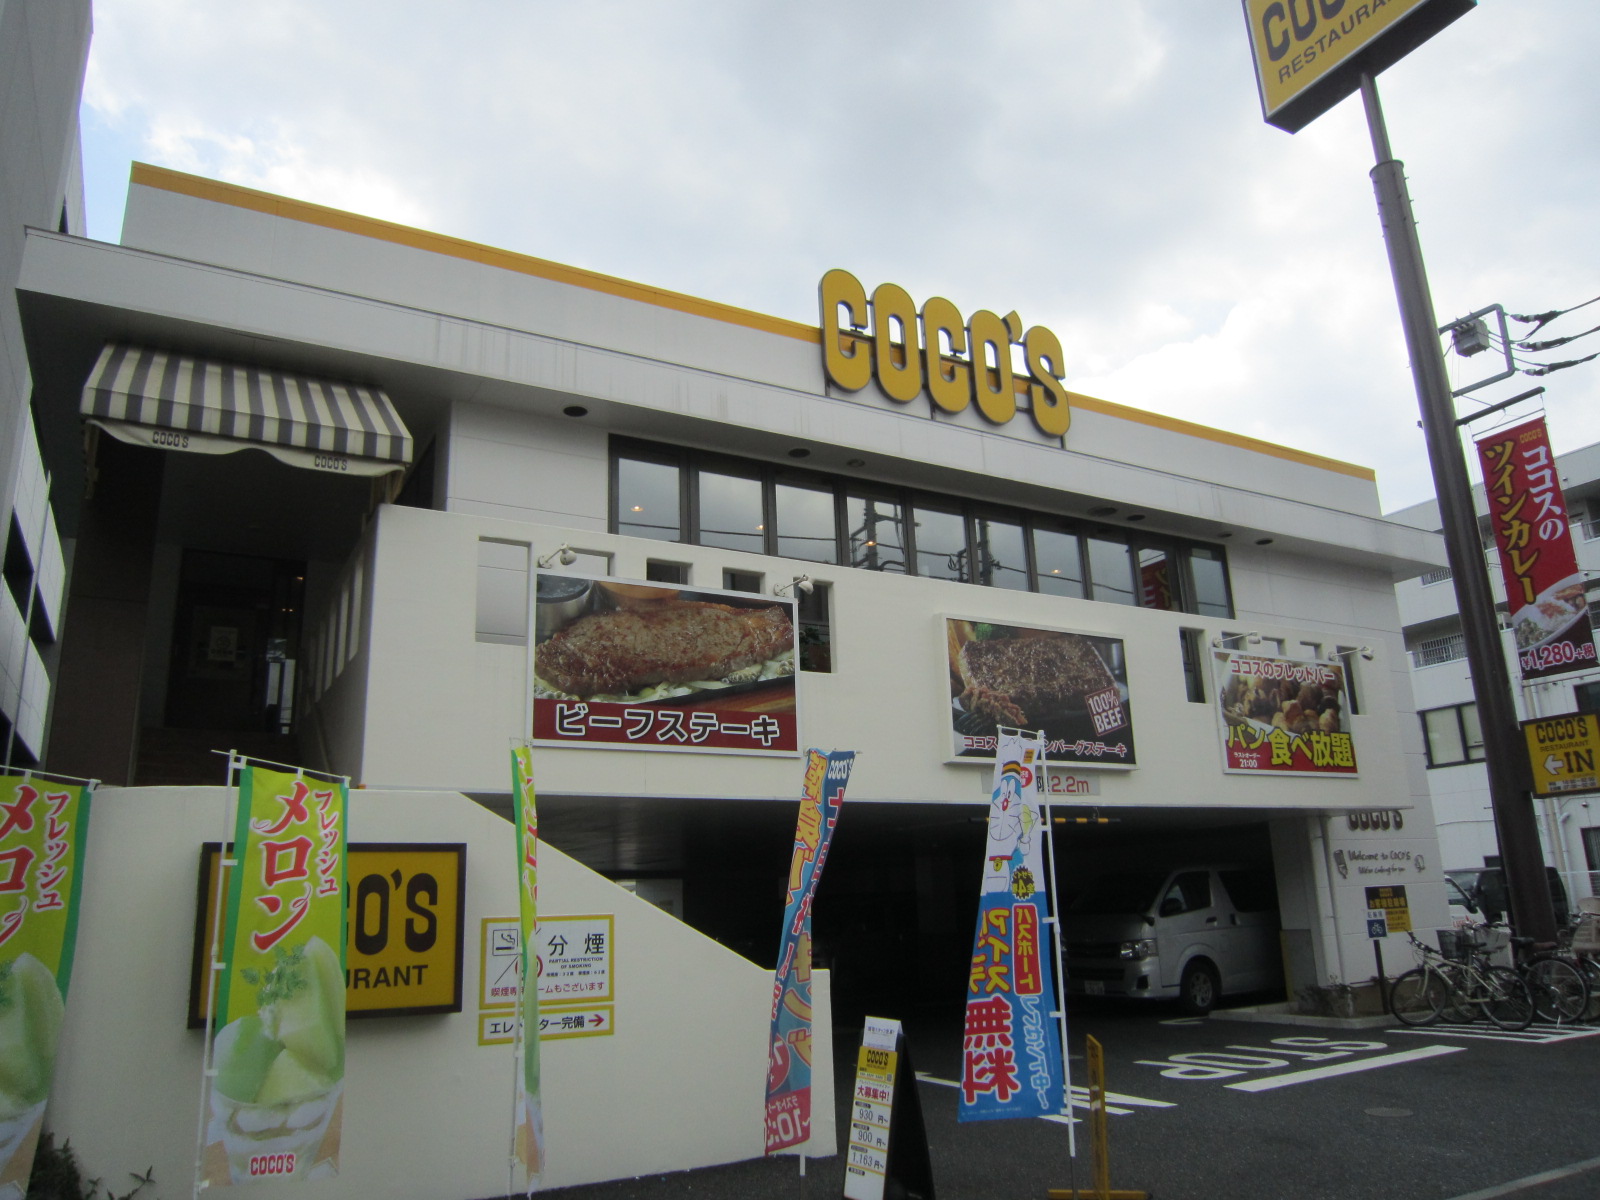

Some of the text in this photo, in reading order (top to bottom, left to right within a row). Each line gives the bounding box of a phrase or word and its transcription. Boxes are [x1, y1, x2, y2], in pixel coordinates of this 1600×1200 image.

[818, 268, 1071, 438] COCO'S
[152, 431, 190, 449] COCO'S
[1519, 428, 1543, 443] COCO'S
[314, 455, 349, 471] COCO'S
[1522, 445, 1565, 541] ココスの
[1483, 440, 1538, 604] ツインカレー
[1230, 659, 1335, 684] ココスのブレッドバー
[1088, 690, 1120, 716] 100%
[555, 703, 781, 746] ビーフステーキ
[1093, 707, 1122, 735] BEEF
[1536, 717, 1589, 744] COCO'S
[963, 735, 1128, 758] ココスンバーグステーキ
[1227, 725, 1354, 768] パン食べ放題
[1540, 740, 1589, 752] RESTAURANT
[1239, 759, 1258, 768] 21:00
[1564, 748, 1595, 773] IN
[1050, 775, 1090, 793] 2.2m
[36, 793, 70, 909] フレッシュ
[315, 791, 338, 895] フレッシュ
[252, 781, 313, 951] メロン
[547, 933, 605, 956] 分煙
[489, 1015, 585, 1034] エレター完備
[866, 1050, 889, 1067] COCO'S
[1133, 1036, 1388, 1080] STOP
[857, 1085, 890, 1102] 大募集中!
[859, 1110, 873, 1121] 930
[857, 1132, 873, 1144] 900
[250, 1154, 294, 1176] COCO'S
